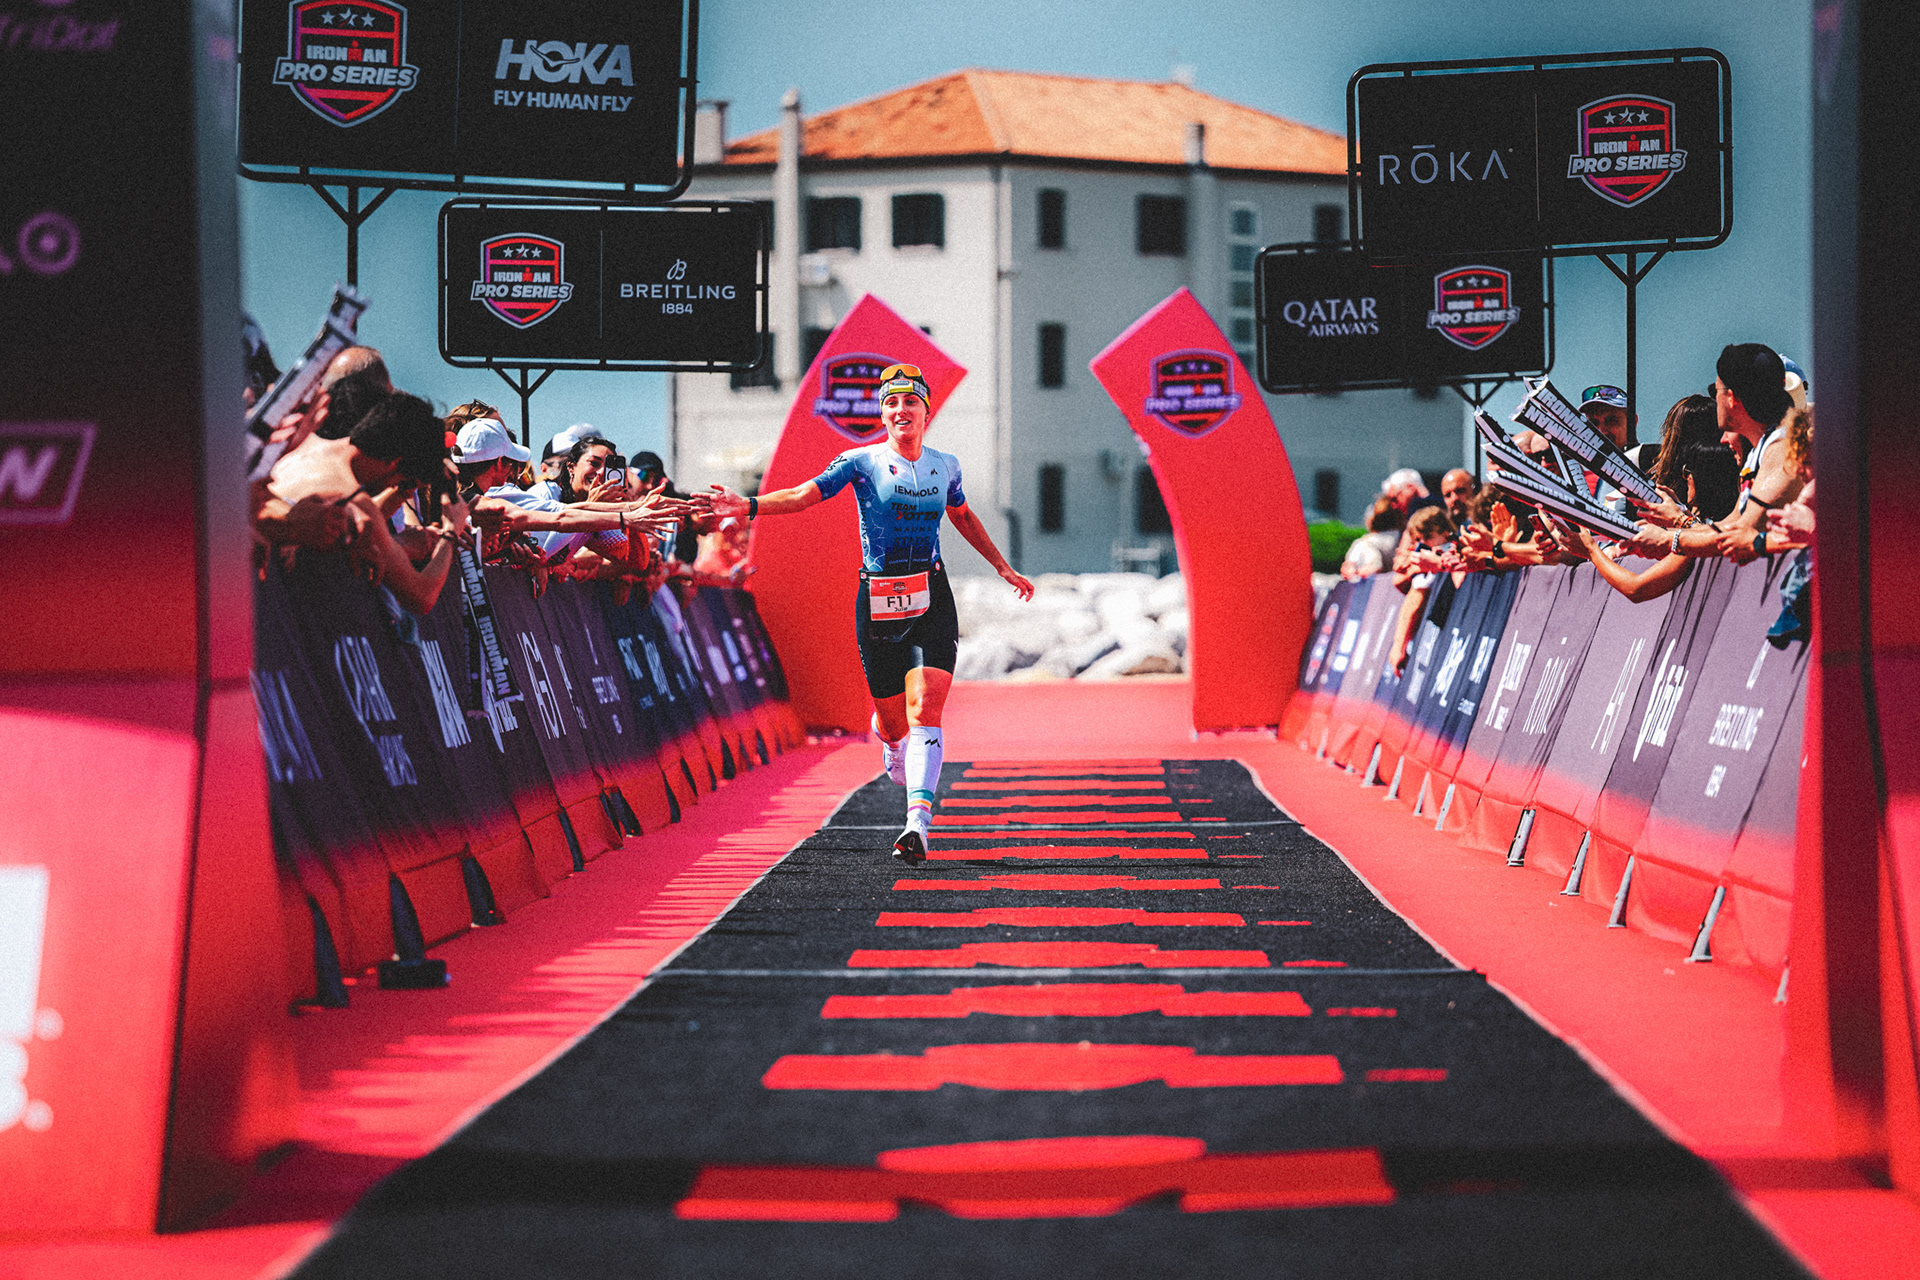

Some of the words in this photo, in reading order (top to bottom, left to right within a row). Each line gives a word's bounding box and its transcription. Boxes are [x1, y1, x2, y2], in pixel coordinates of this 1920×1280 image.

[306, 41, 387, 63] IRONMAN
[495, 38, 634, 86] HOKA
[278, 62, 328, 82] PRO
[330, 65, 414, 86] SERIES
[494, 90, 524, 106] FLY
[526, 92, 599, 111] HUMAN
[601, 95, 633, 112] FLY
[1593, 134, 1661, 154] IRONMAN
[1571, 156, 1612, 174] PRO
[1614, 153, 1684, 172] SERIES
[493, 267, 551, 283] IRONMAN
[474, 284, 508, 298] PRO
[511, 285, 571, 299] SERIES
[620, 283, 736, 300] BREITLING
[662, 303, 693, 315] 1884
[1283, 297, 1377, 327] QATAR
[1430, 312, 1462, 325] PRO
[1464, 309, 1519, 323] SERIES
[1308, 321, 1380, 337] AIRWAYS
[1535, 387, 1604, 450] IRONMAN
[1524, 404, 1599, 462] IRONMAN
[894, 484, 939, 498] IEMMOLO
[891, 502, 917, 511] TEAM
[887, 594, 911, 608] F11
[477, 615, 511, 696] IRONMAN
